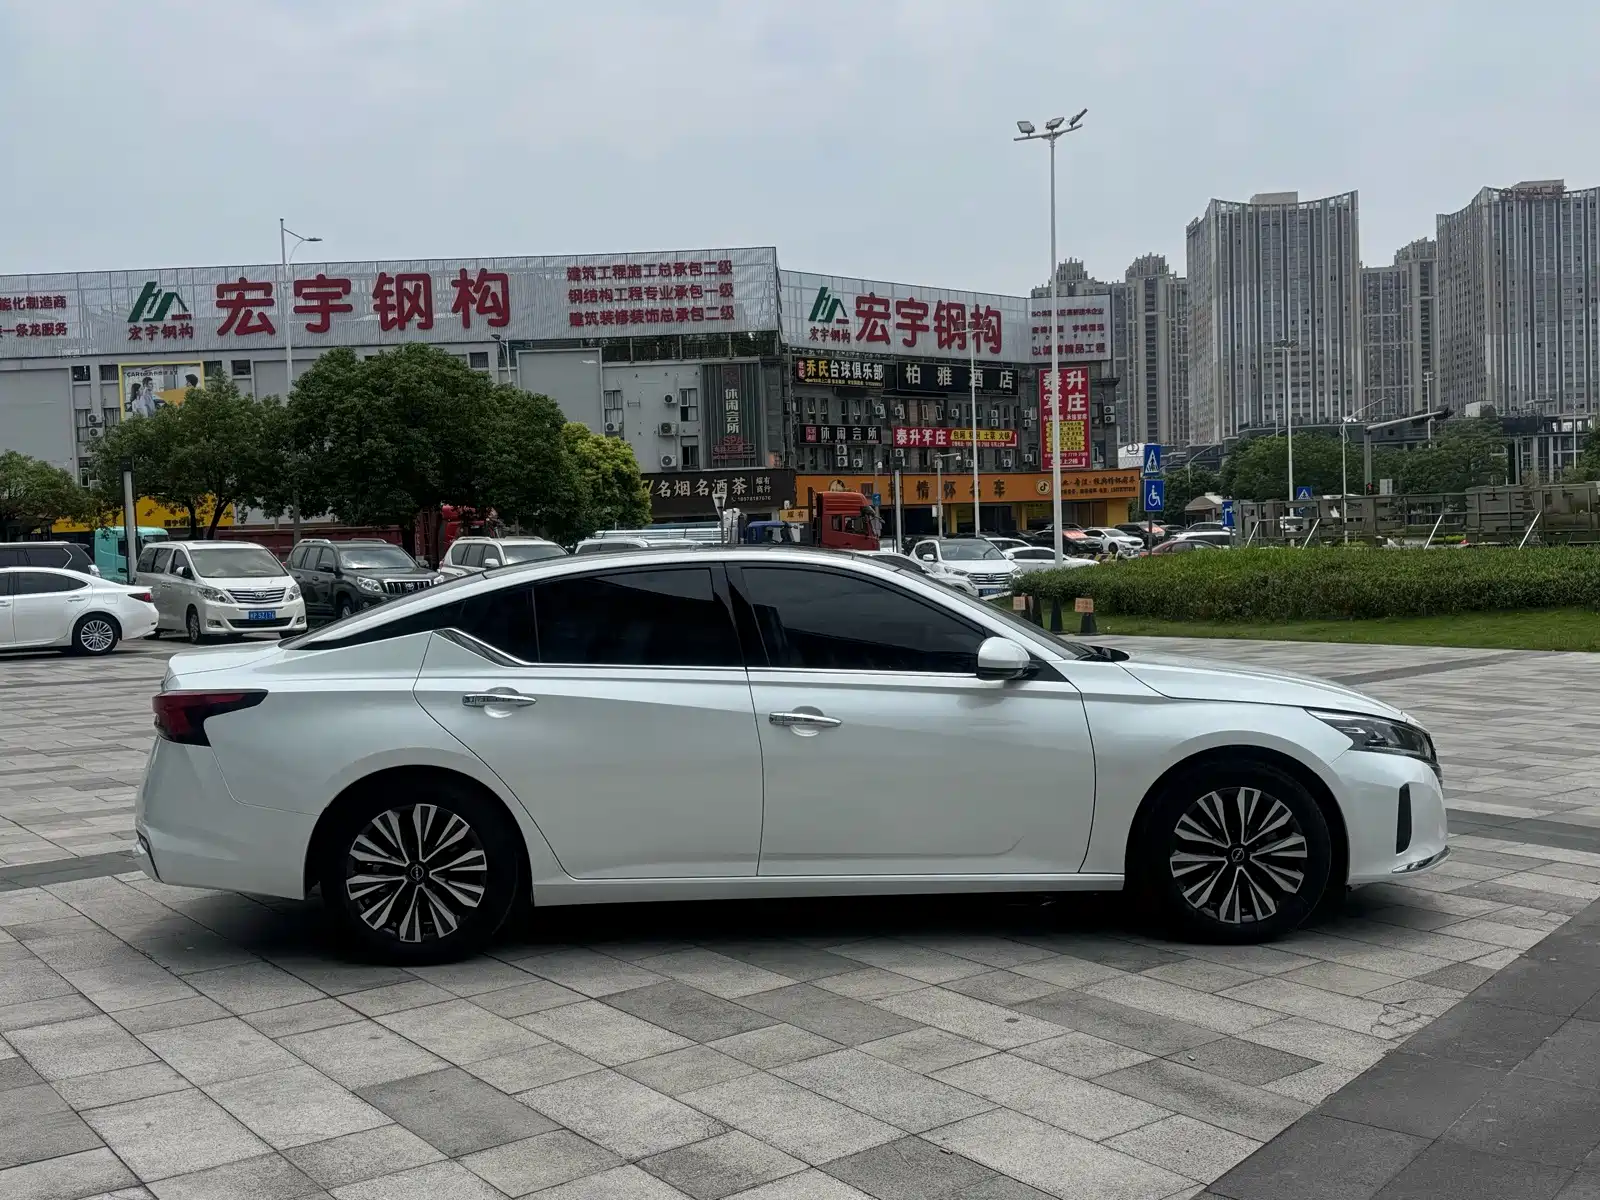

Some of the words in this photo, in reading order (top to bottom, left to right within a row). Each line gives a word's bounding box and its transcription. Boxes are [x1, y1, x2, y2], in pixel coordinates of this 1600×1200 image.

[566, 259, 733, 281] 建筑工程施工总承包二级
[215, 267, 511, 336] 宏宇钢构
[567, 282, 734, 304] 钢结构工程专业承包一级
[569, 305, 735, 327] 建筑装修装饰总承包二级
[855, 291, 1001, 354] 宏宇钢构
[0, 322, 68, 338] 一条龙服务
[127, 323, 194, 341] 宏宇钢构
[809, 326, 850, 344] 宏宇钢构
[807, 360, 884, 380] 乔氏台球俱乐部
[905, 363, 1013, 389] 柏雅酒店
[725, 388, 739, 433] 休闲会所
[820, 426, 877, 440] 休闲会所
[656, 477, 748, 498] 名烟名酒茶
